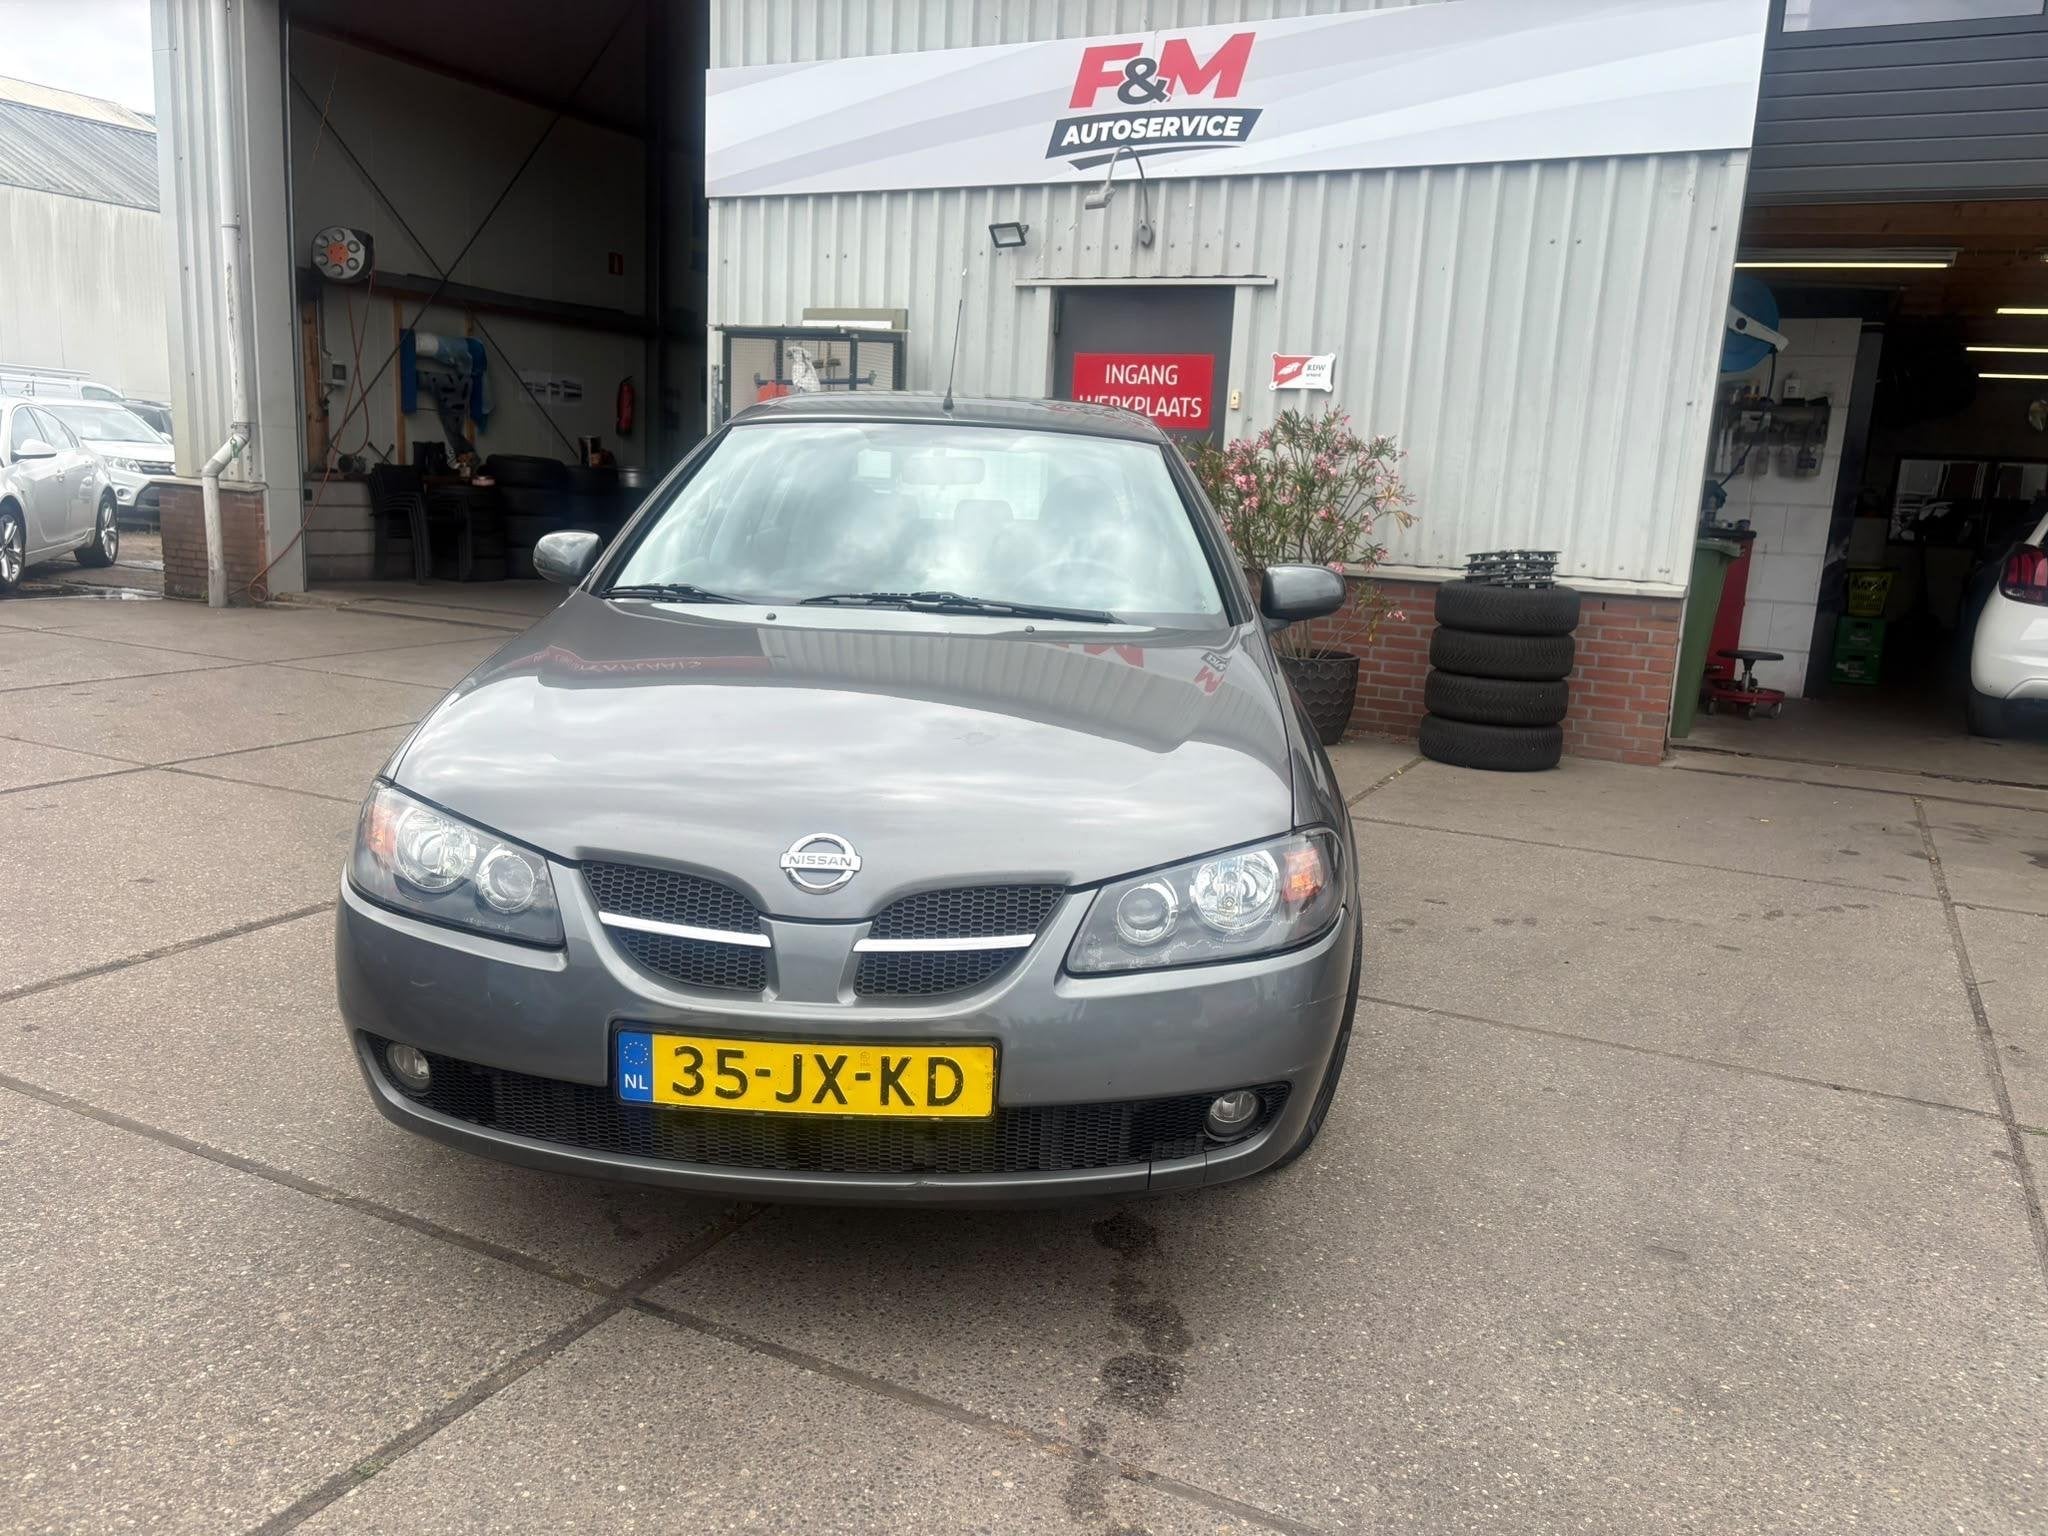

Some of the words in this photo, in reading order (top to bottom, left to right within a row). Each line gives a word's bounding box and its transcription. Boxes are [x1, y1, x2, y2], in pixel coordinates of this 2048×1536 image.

[1069, 32, 1256, 109] F&M
[1061, 115, 1243, 146] AUTOSERVICE
[1105, 364, 1178, 385] INGANG
[788, 855, 852, 867] NISSAN
[624, 1073, 648, 1090] NL
[672, 1045, 964, 1106] 35-JX-KD
